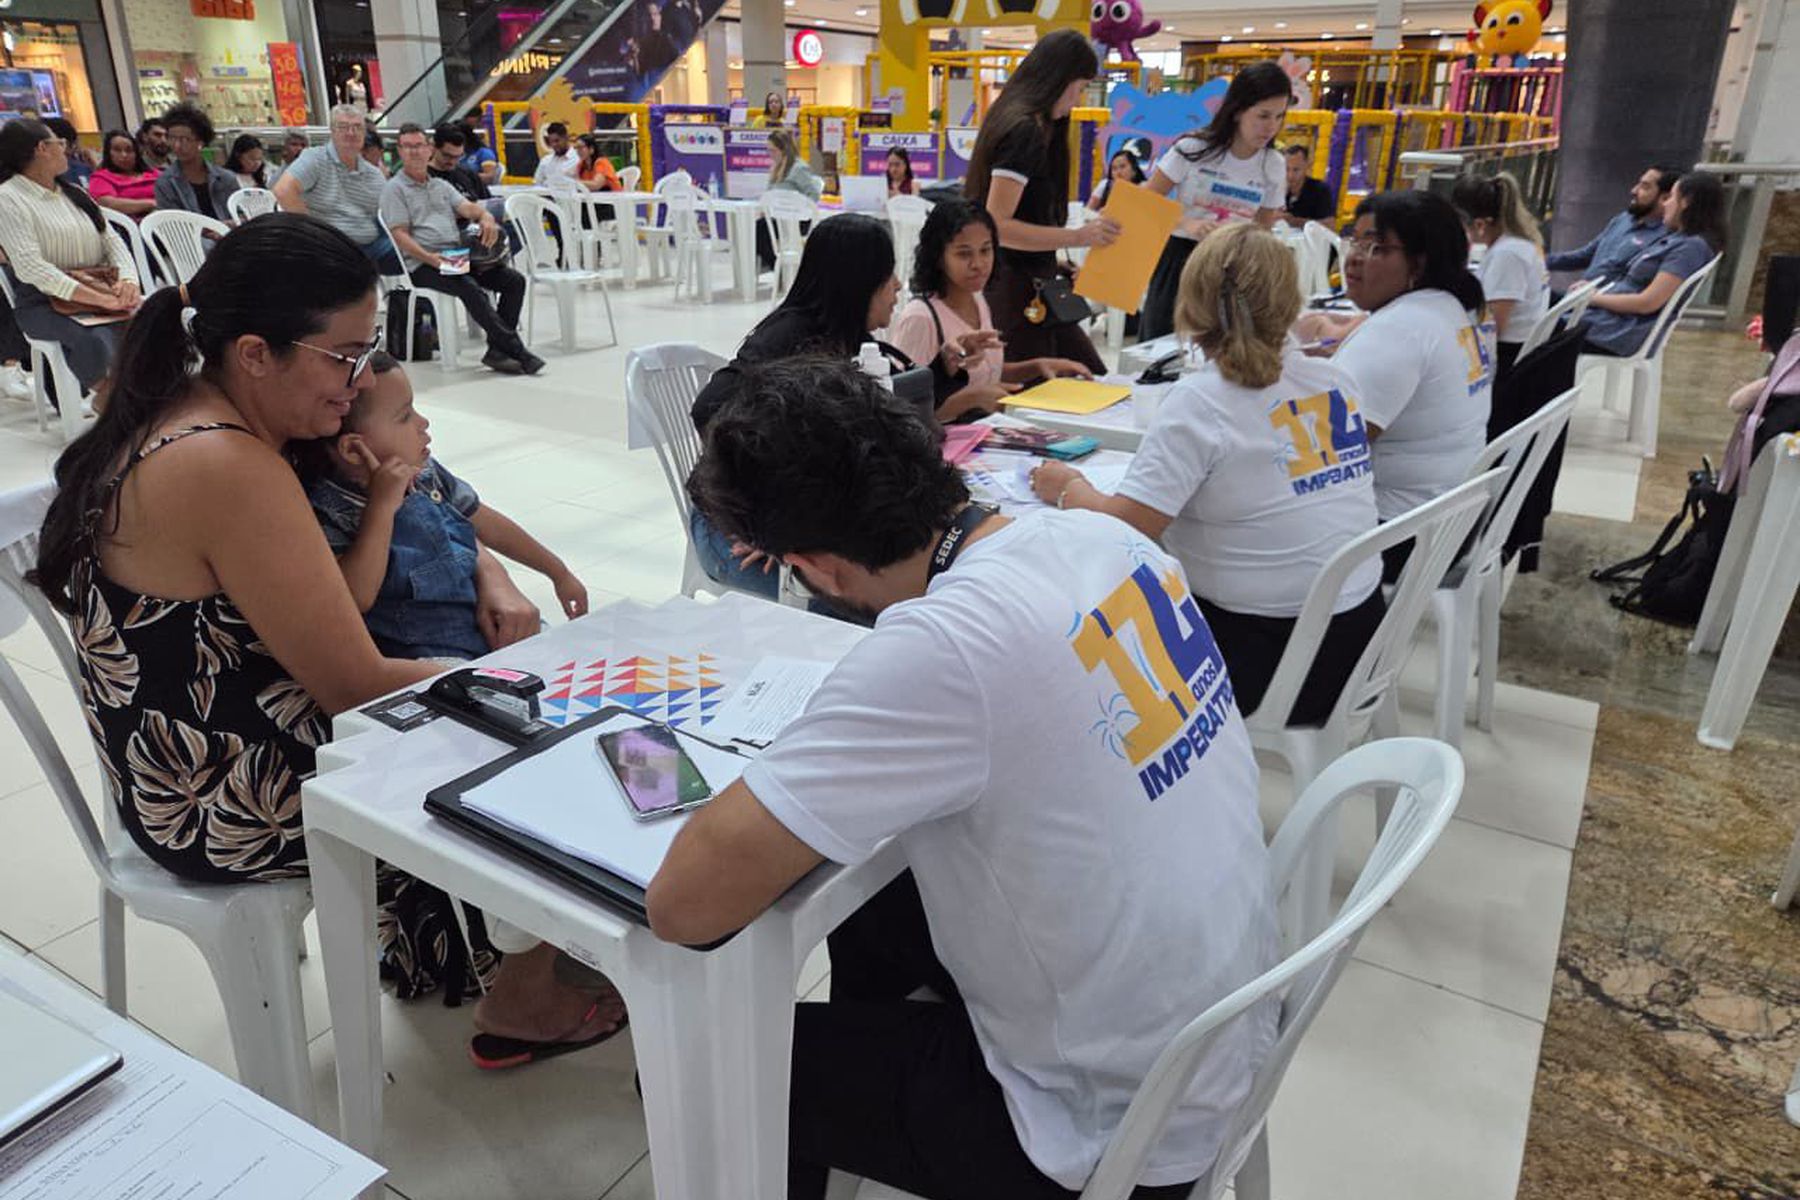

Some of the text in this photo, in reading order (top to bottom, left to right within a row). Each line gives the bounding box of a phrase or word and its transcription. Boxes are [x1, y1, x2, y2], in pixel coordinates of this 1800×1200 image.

[882, 135, 917, 145] CAIXA
[935, 526, 963, 566] SEDEC
[1191, 662, 1219, 697] anos
